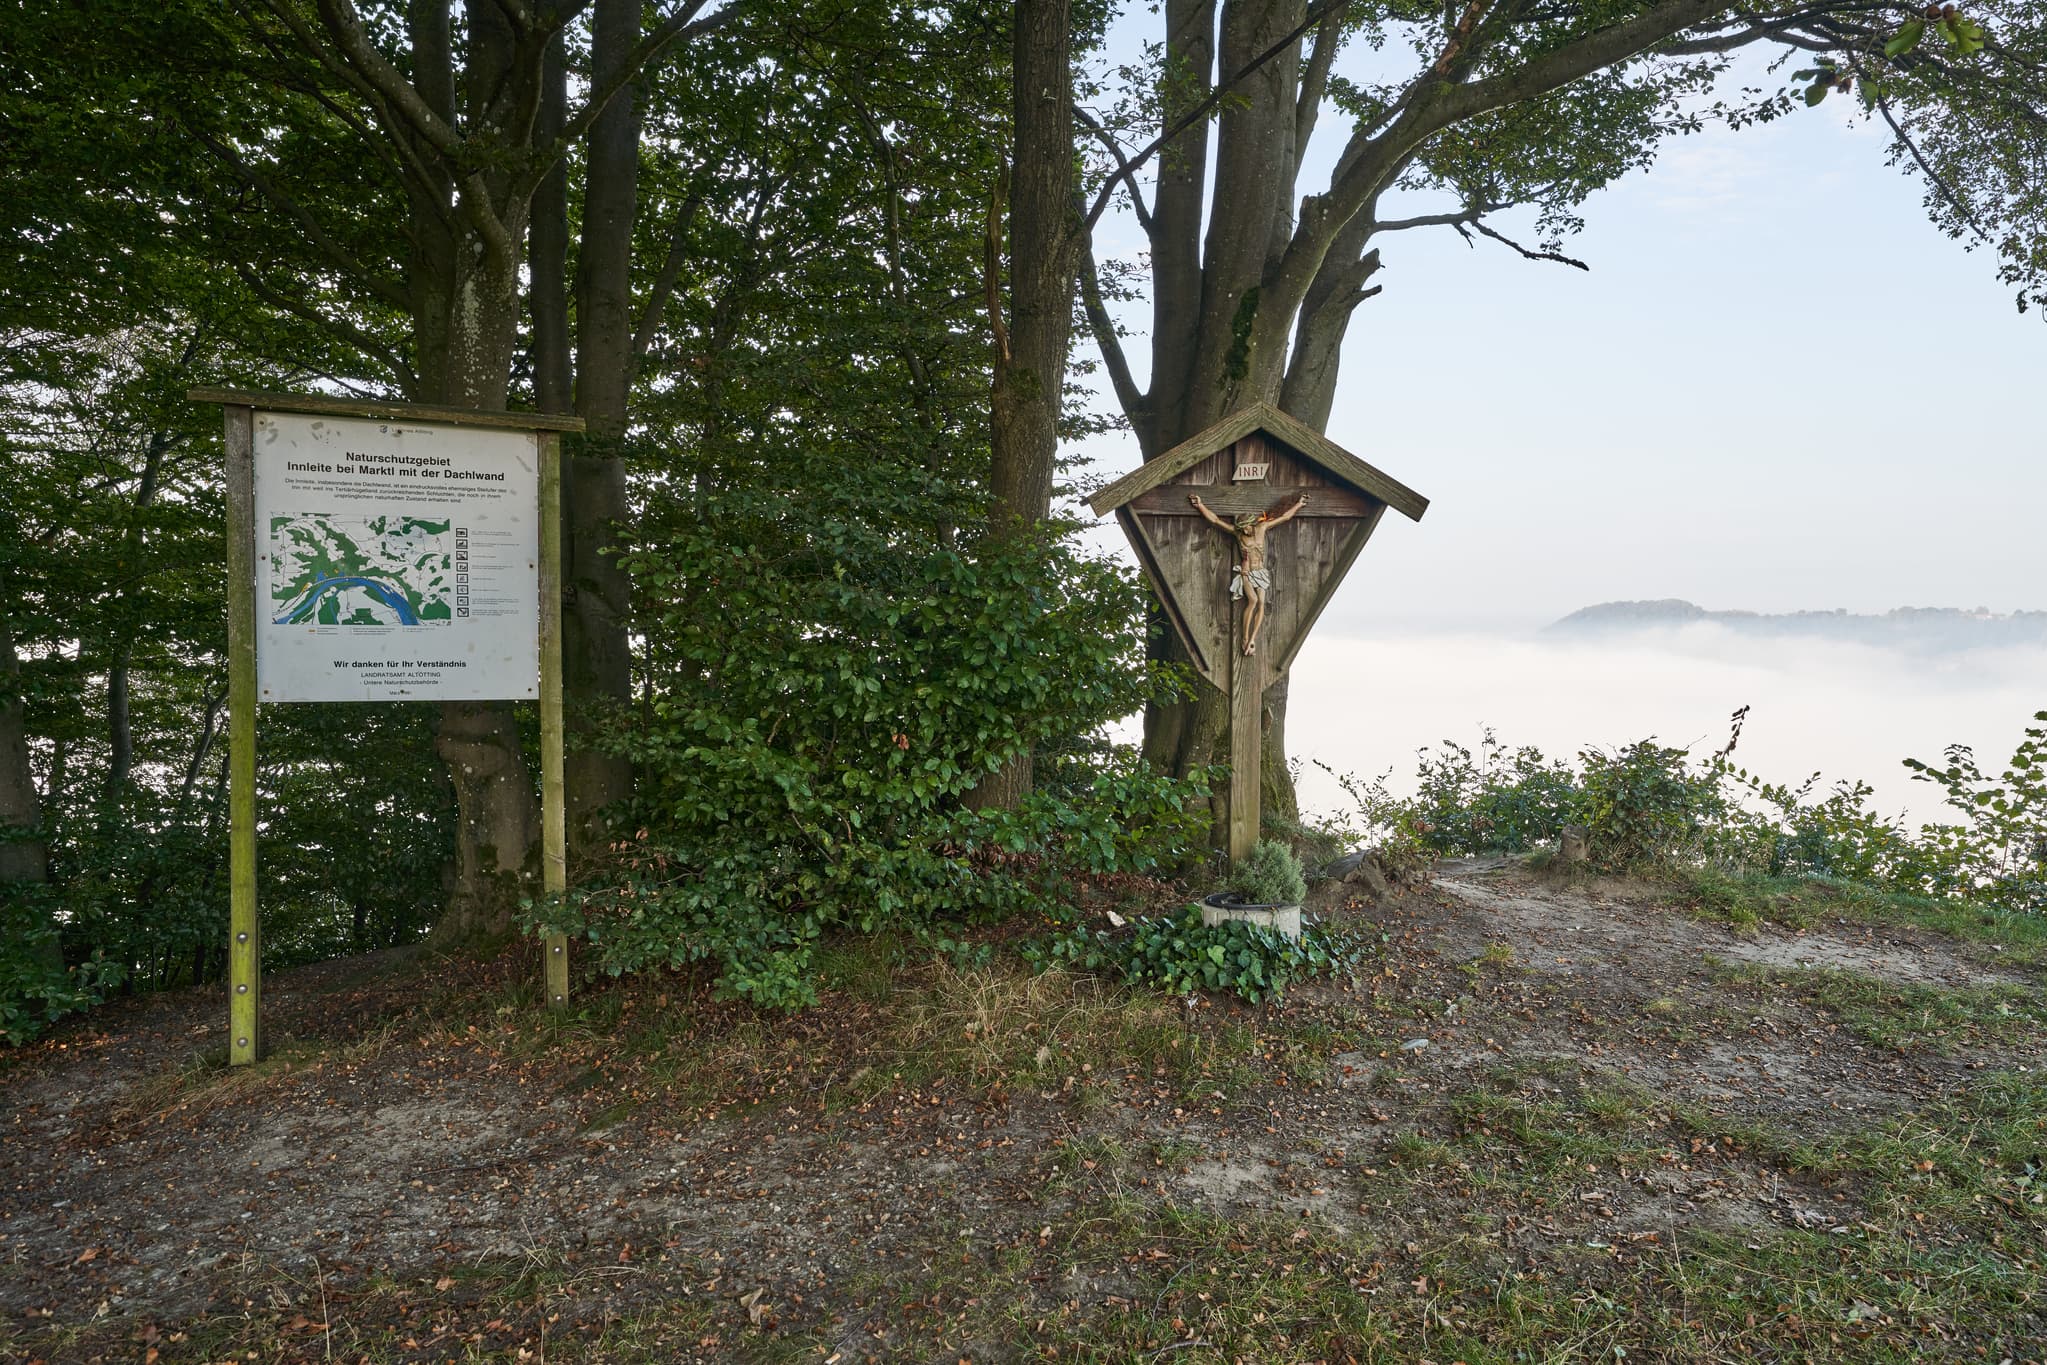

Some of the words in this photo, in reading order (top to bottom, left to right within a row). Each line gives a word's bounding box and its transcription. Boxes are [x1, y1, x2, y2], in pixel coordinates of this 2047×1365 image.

[346, 452, 451, 466] Naturschutzgebiet
[287, 462, 332, 472] Innleite
[337, 464, 354, 474] bei
[359, 466, 395, 476] Marktl
[399, 467, 417, 476] mit
[422, 468, 440, 478] der
[444, 469, 504, 481] Dachlwand
[1239, 466, 1263, 477] INRI
